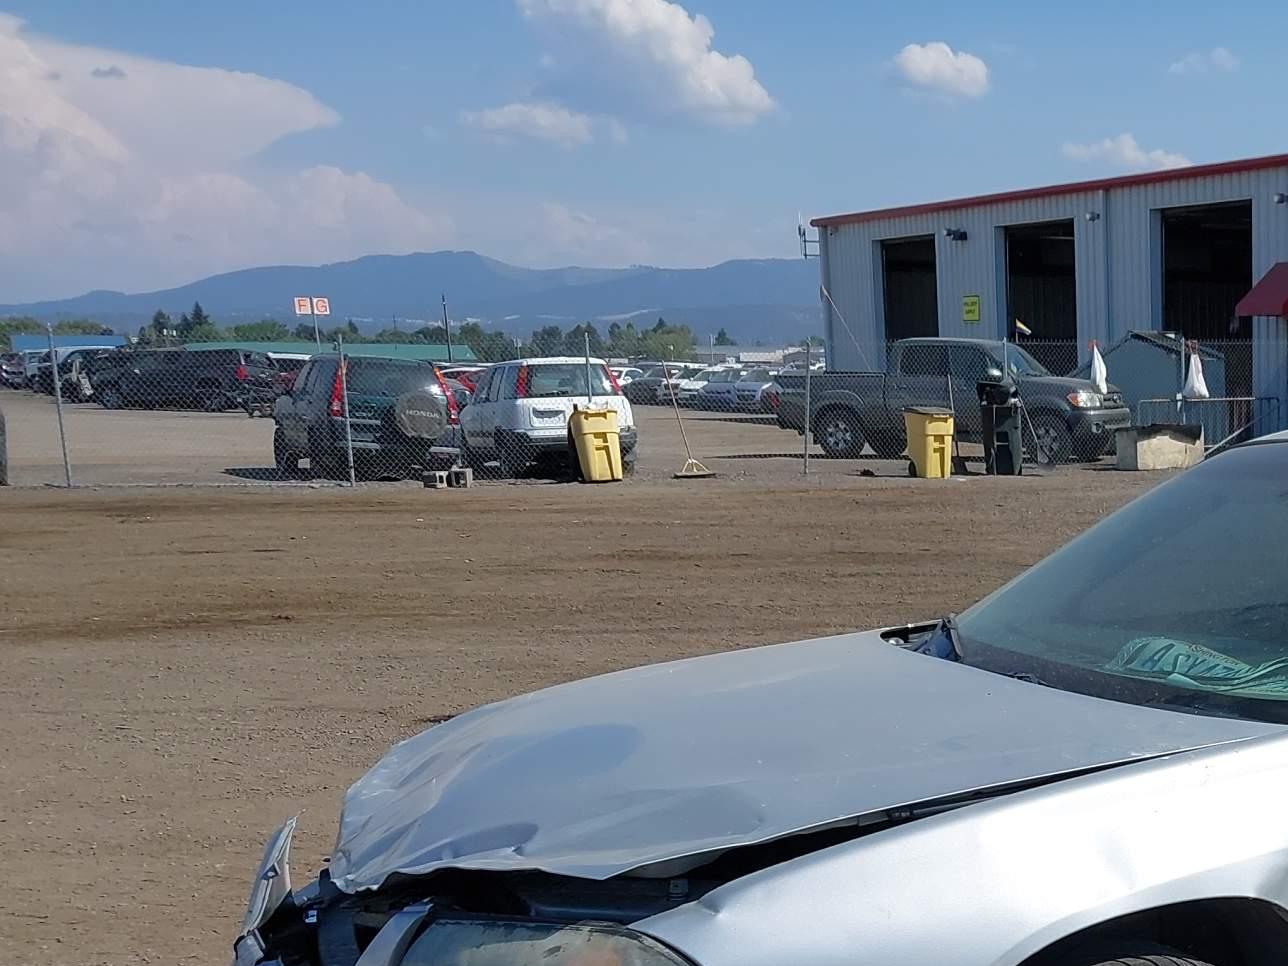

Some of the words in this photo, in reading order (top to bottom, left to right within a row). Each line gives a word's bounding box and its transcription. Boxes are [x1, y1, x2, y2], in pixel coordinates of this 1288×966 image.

[298, 299, 307, 313] F
[316, 299, 328, 313] G
[406, 409, 441, 419] HONDA
